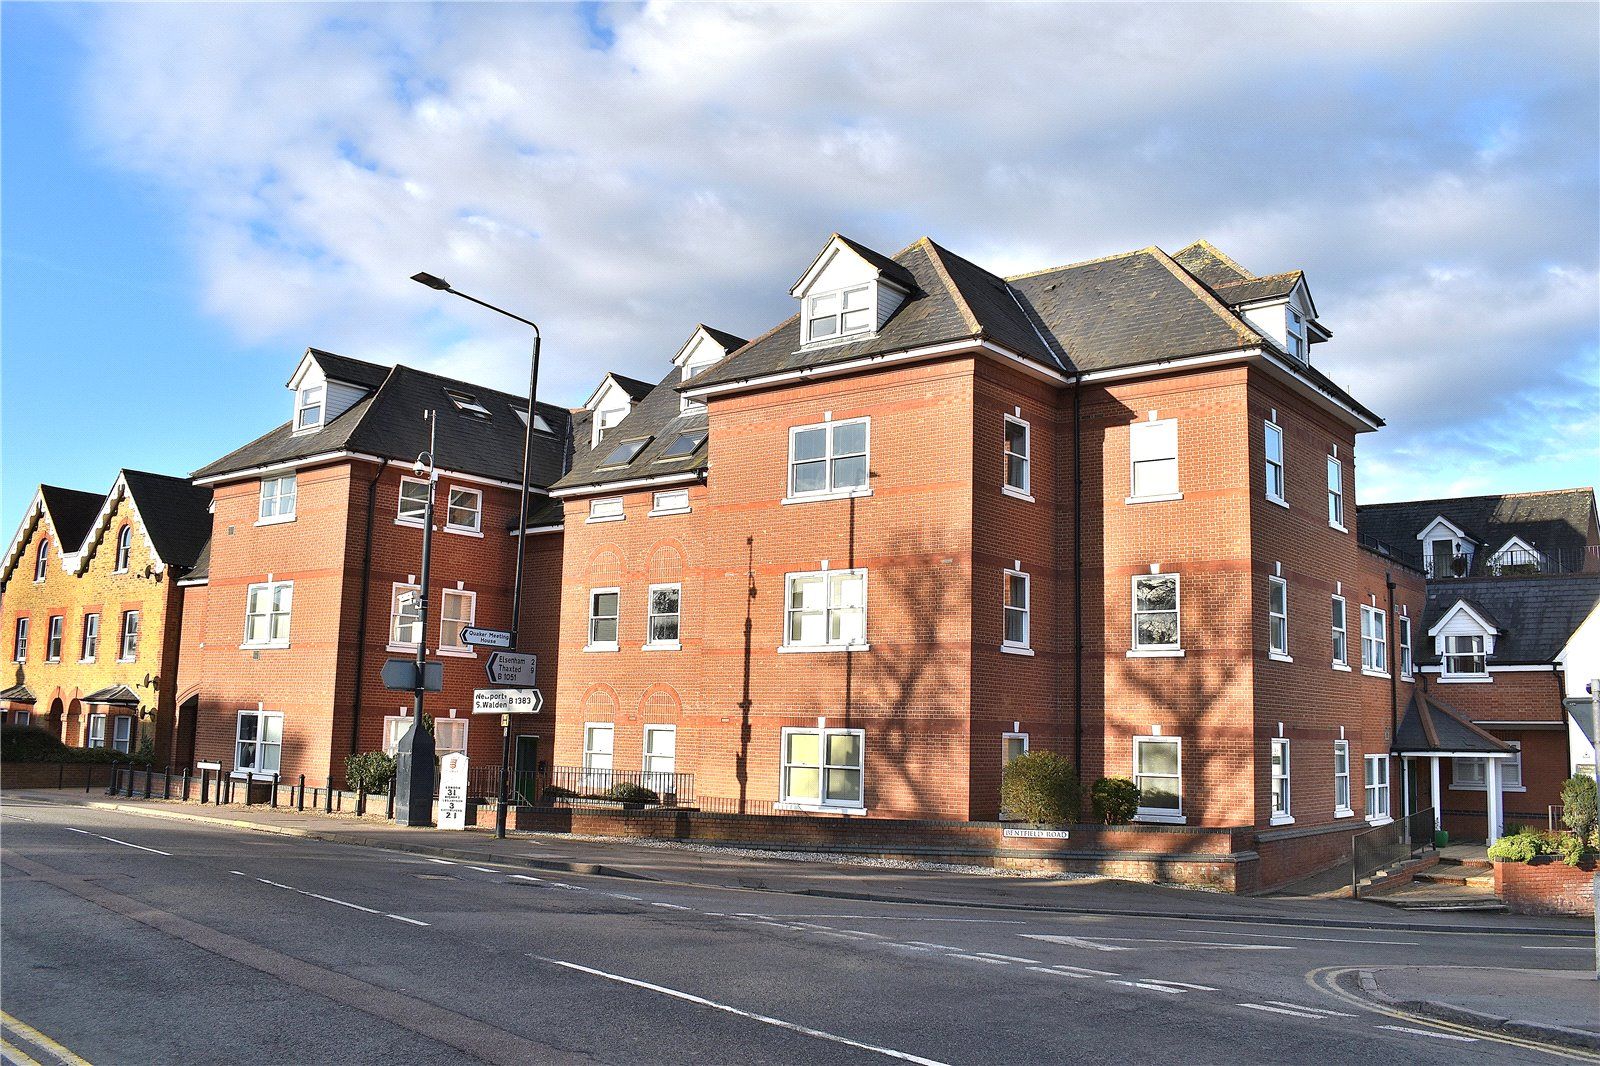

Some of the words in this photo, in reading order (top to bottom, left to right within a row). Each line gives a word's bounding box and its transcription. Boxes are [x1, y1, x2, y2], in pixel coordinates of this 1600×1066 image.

[489, 632, 509, 640] Meeting
[499, 655, 526, 664] Elsenham
[499, 664, 522, 673] Thaxted
[497, 672, 503, 680] B
[503, 673, 517, 681] 1051
[475, 701, 508, 709] S.Walden
[515, 697, 532, 705] 1383
[1005, 829, 1044, 837] BENTFIELD
